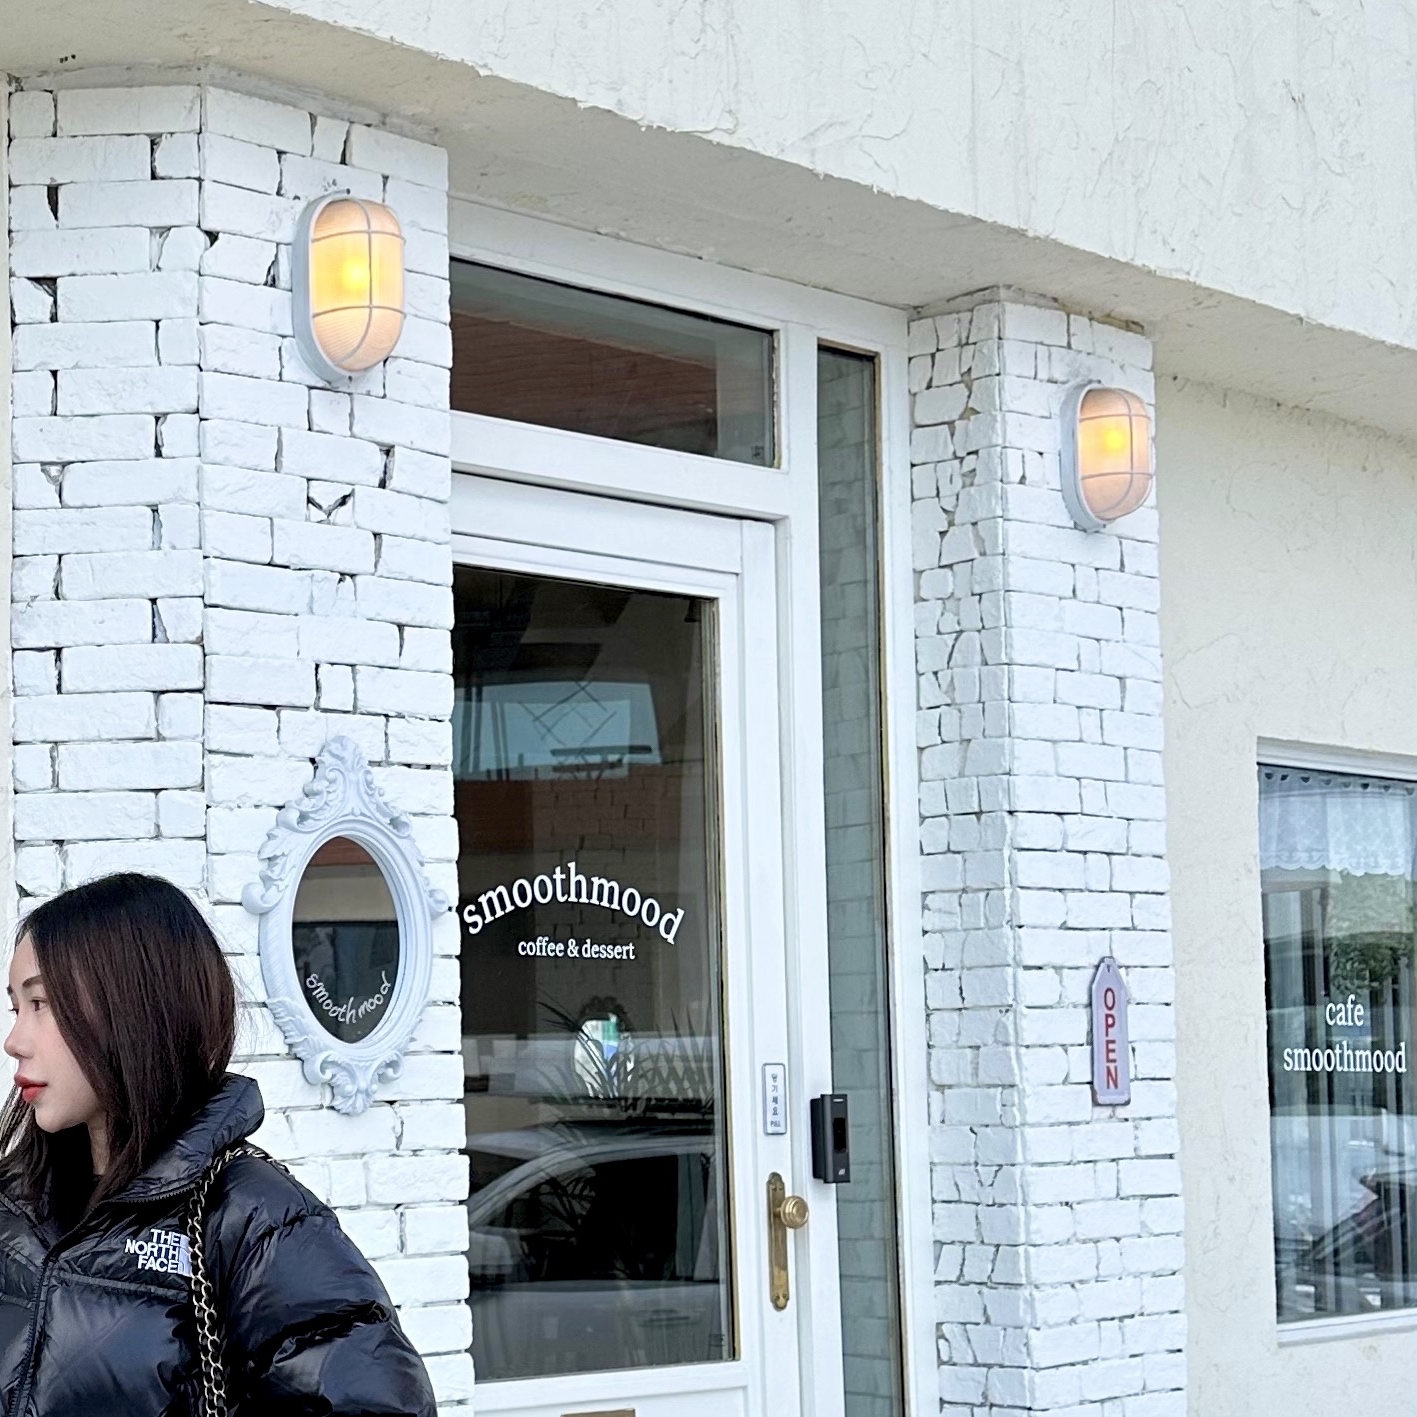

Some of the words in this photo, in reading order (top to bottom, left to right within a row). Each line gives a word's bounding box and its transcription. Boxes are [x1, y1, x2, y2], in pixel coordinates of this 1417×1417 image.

[462, 861, 684, 945] smoothmood
[517, 936, 564, 957] coffee
[567, 938, 579, 958] &
[582, 938, 635, 960] dessert
[1325, 994, 1364, 1027] cafe
[1104, 987, 1119, 1090] OPEN
[1283, 1041, 1407, 1074] smoothmood
[124, 1238, 180, 1261] NORTH
[150, 1228, 181, 1247] THE
[137, 1255, 179, 1274] FACE
